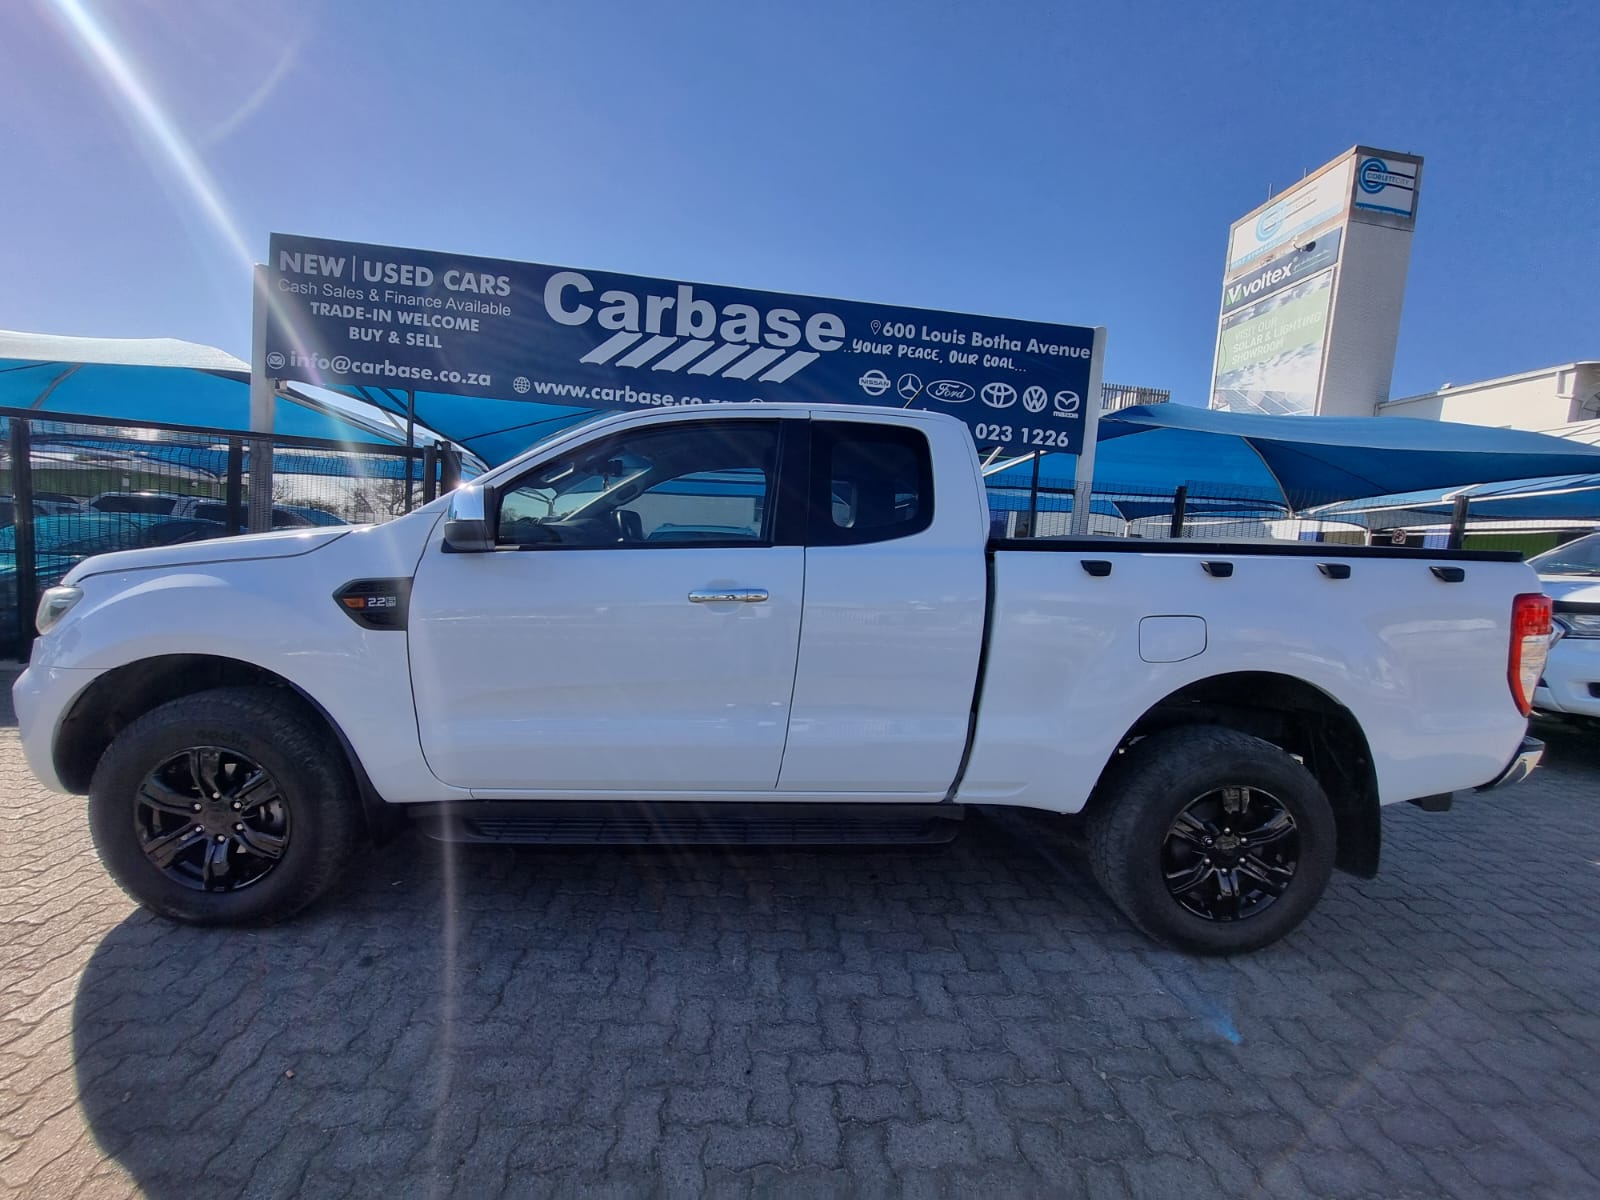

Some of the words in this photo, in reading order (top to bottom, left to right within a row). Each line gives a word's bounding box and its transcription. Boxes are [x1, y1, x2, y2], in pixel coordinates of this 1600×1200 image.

[279, 250, 345, 278] NEW
[363, 260, 434, 288] USED
[443, 270, 511, 297] CARS
[1242, 263, 1293, 297] voltex
[277, 278, 318, 297] Cash
[322, 282, 364, 301] Sales
[369, 287, 380, 302] &
[384, 289, 442, 309] Finance
[446, 297, 512, 317] Available
[543, 271, 846, 352] Carbase
[310, 301, 392, 324] TRADE-IN
[397, 311, 480, 332] WELCOME
[1258, 317, 1278, 332] OUR
[348, 326, 384, 344] BUY
[388, 330, 401, 345] &
[405, 332, 442, 349] SELL
[882, 321, 916, 339] 600
[921, 326, 966, 345] Louis
[971, 331, 1022, 352] Botha
[1026, 338, 1091, 359] Avenue
[1233, 333, 1264, 353] SOLAR
[1273, 312, 1322, 338] LIGHTING
[949, 350, 978, 365] OUR
[1231, 337, 1284, 365] SHOWROOM
[290, 352, 492, 387] info@carbase.co.za
[860, 377, 891, 388] NISSAN
[935, 383, 967, 400] Ford
[975, 422, 1013, 443] 023
[1021, 426, 1070, 448] 1226
